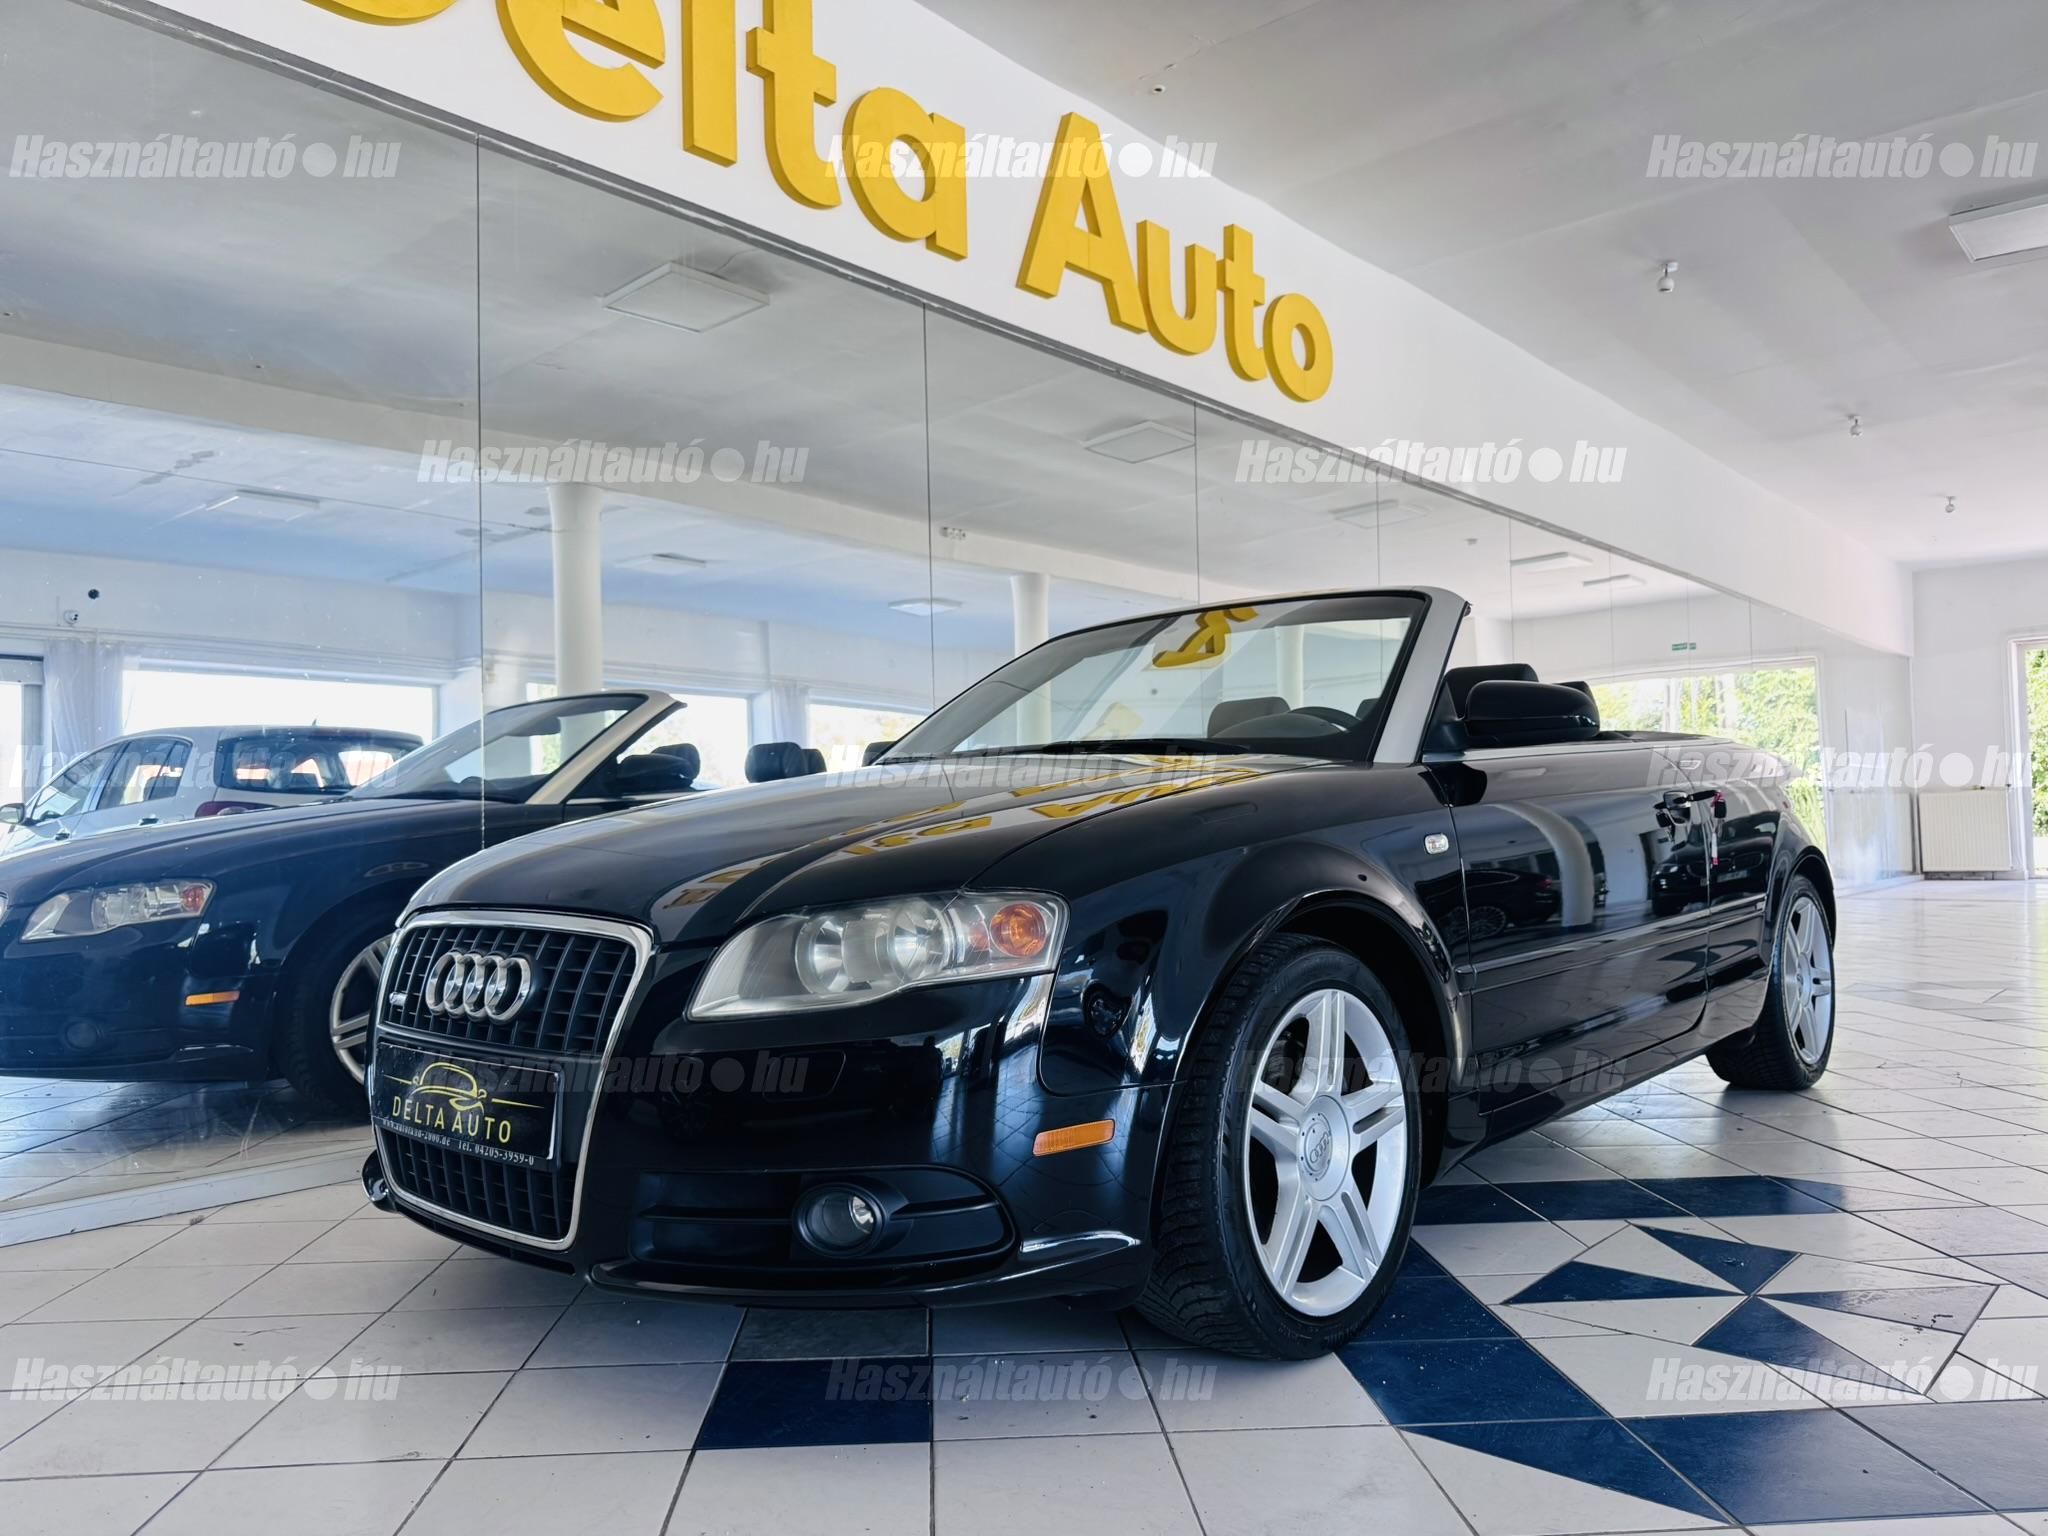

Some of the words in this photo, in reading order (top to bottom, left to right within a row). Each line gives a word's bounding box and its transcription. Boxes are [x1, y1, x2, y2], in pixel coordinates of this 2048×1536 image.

[304, 0, 968, 262] elta
[1015, 111, 1334, 403] Auto
[392, 1095, 446, 1130] DELTA
[451, 1111, 512, 1143] AUTO
